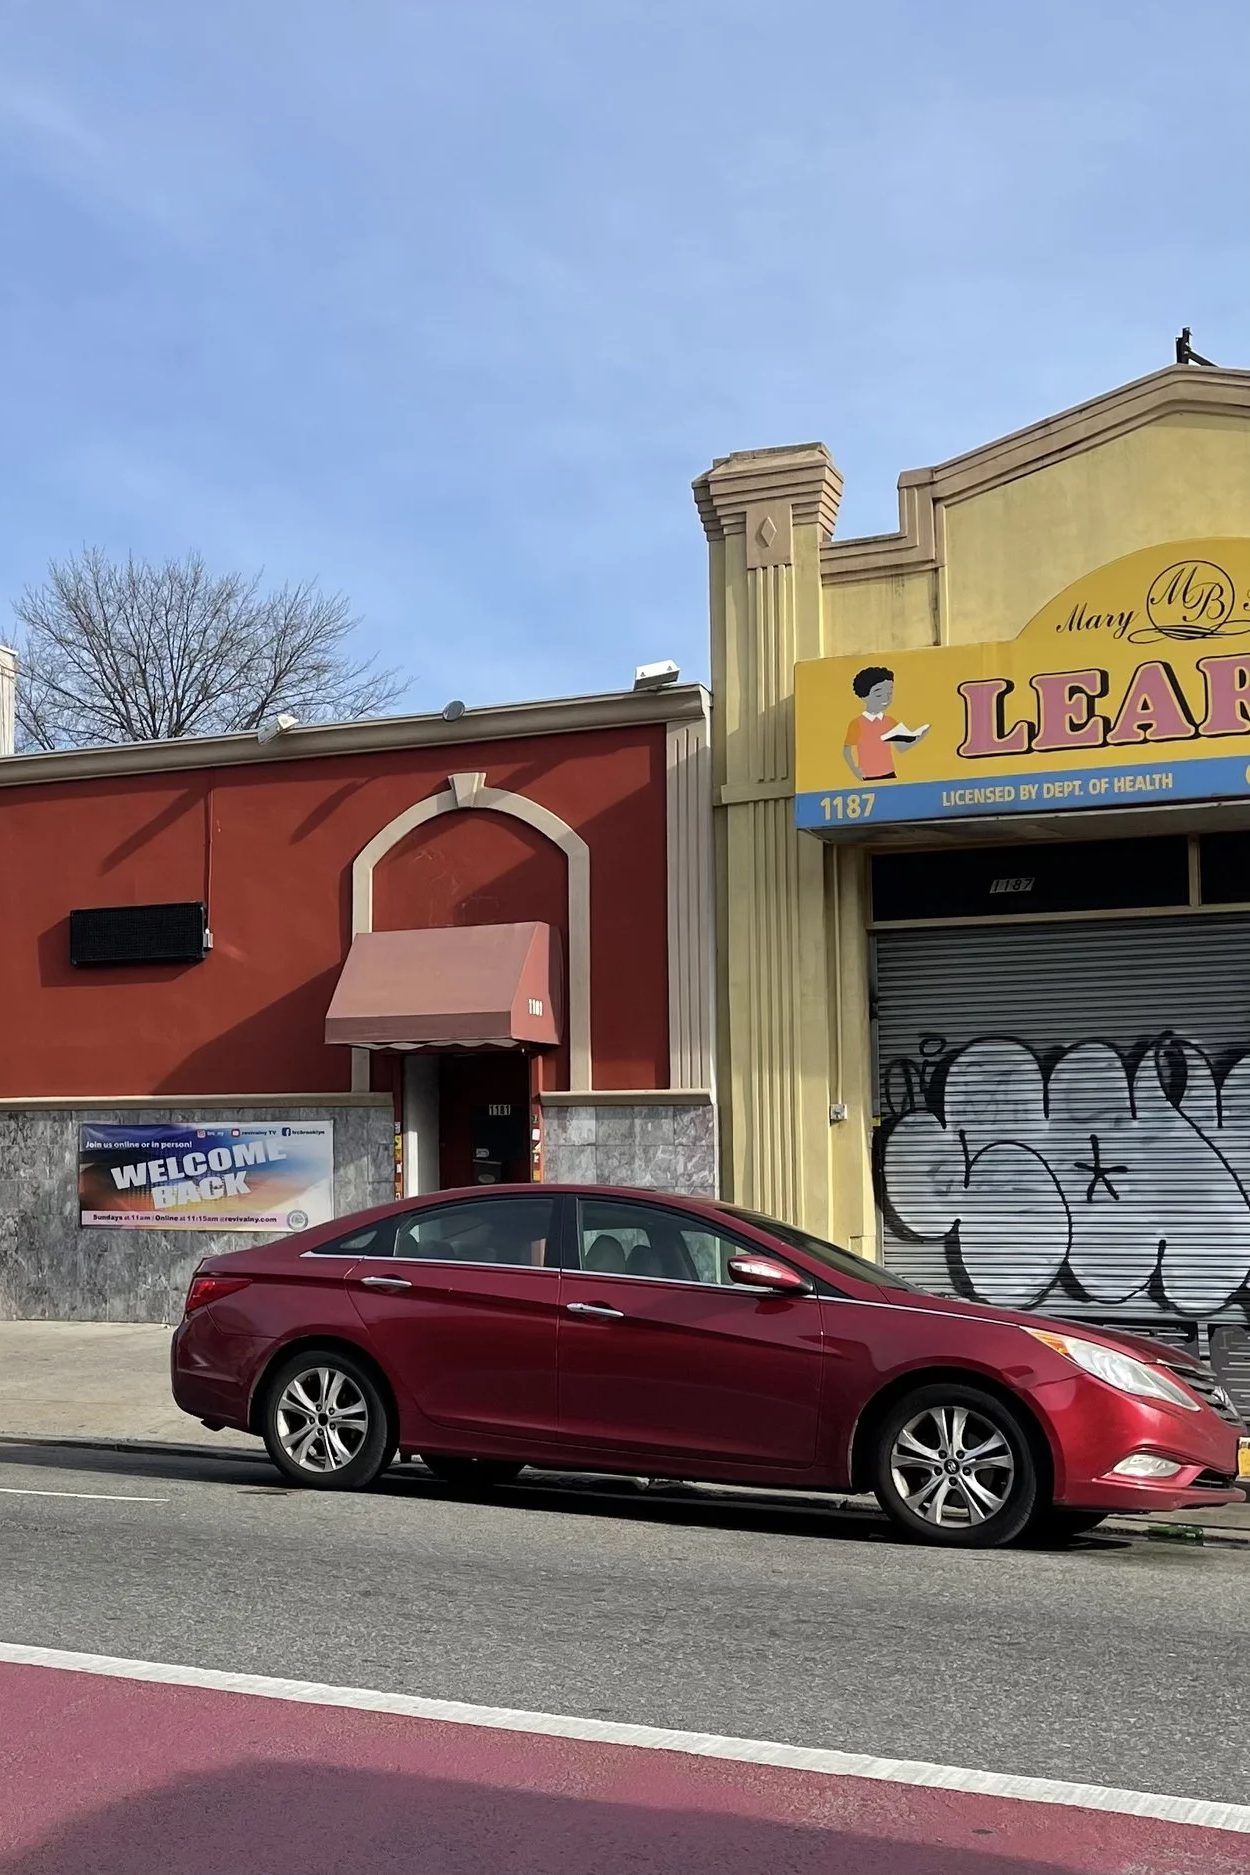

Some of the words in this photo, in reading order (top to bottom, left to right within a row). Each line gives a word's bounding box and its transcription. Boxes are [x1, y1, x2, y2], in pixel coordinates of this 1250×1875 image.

[1056, 602, 1141, 640] Mary
[942, 786, 1015, 807] LICENSED
[1019, 784, 1039, 800] BY
[1043, 780, 1084, 798] DEPT.
[1088, 778, 1110, 795] OF
[1114, 772, 1173, 793] HEALTH
[820, 792, 876, 821] 1187
[990, 878, 1035, 893] 1187
[489, 1104, 510, 1116] 1181
[85, 1141, 102, 1149] Join
[114, 1141, 140, 1149] online
[151, 1141, 160, 1149] in
[161, 1140, 193, 1150] person!
[111, 1137, 287, 1190] WELCOME
[151, 1170, 252, 1210] BACK
[93, 1214, 123, 1222] Sundays
[155, 1214, 179, 1222] Online
